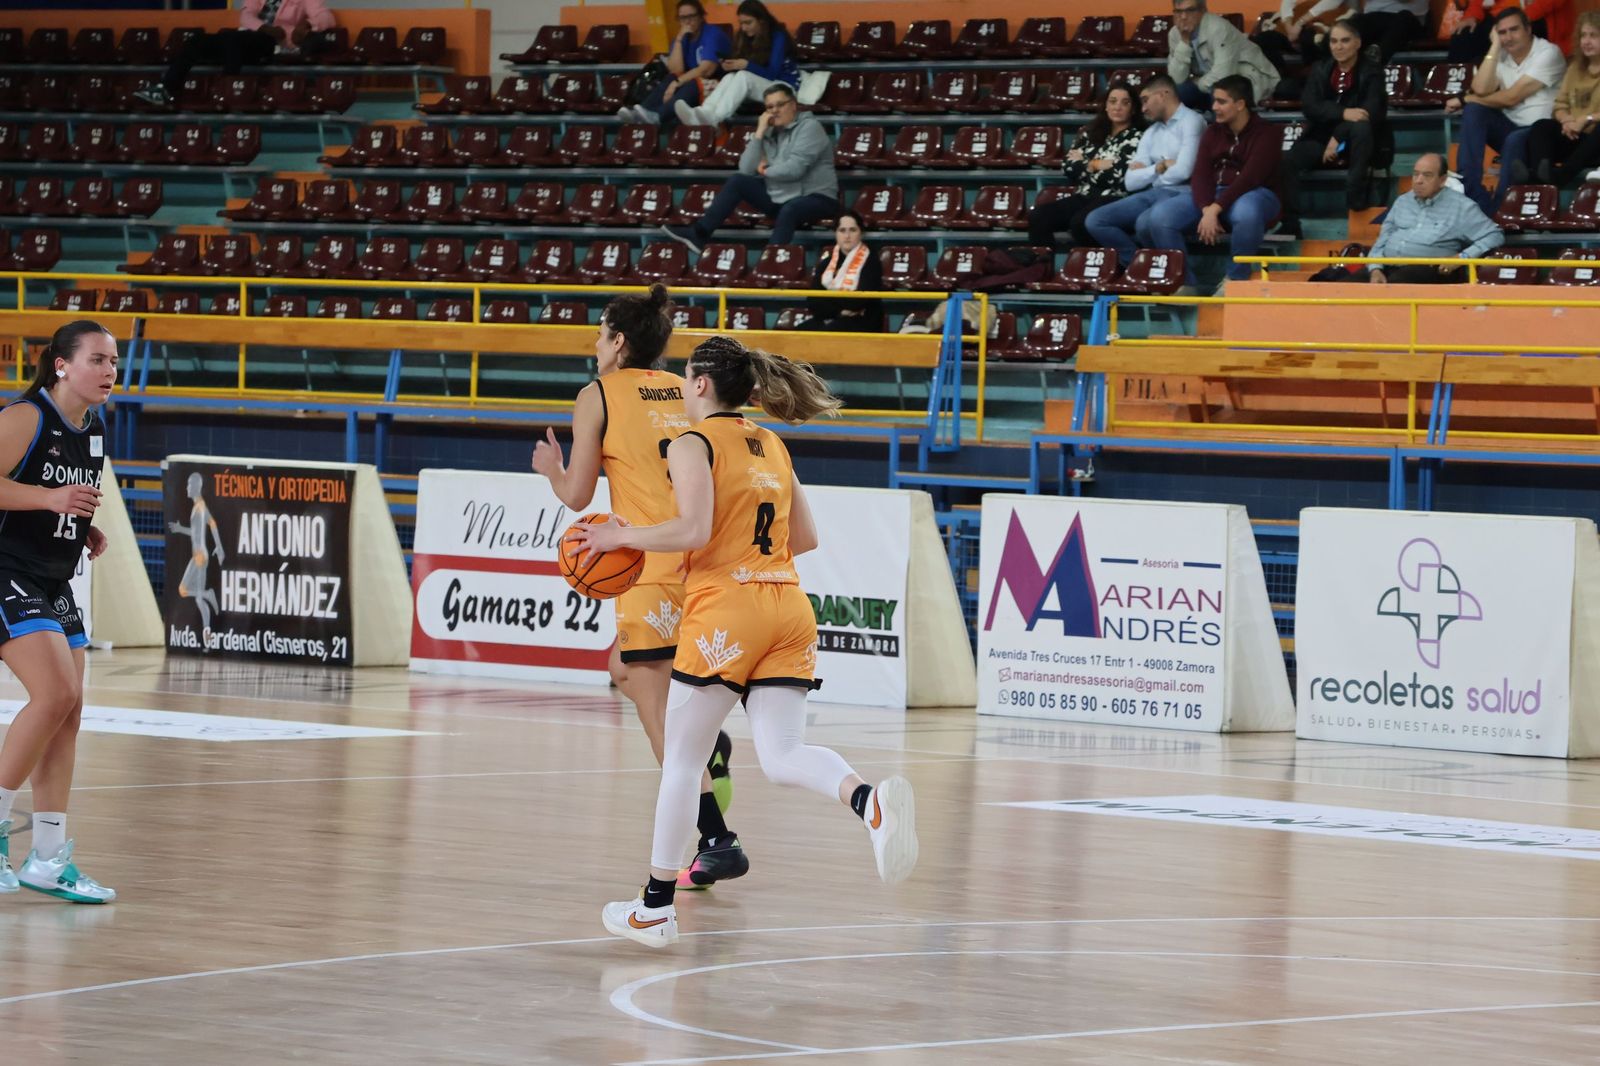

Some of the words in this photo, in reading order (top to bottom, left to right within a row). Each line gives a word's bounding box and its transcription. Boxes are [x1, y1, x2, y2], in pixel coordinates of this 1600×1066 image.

[214, 469, 264, 498] TÉCNICA
[268, 478, 276, 498] Y
[279, 479, 347, 503] ORTOPEDIA
[53, 513, 77, 540] 15
[237, 512, 326, 559] ANTONIO
[752, 502, 775, 556] 4
[1142, 557, 1179, 570] Asesoria
[221, 562, 341, 619] HERNÁNDEZ
[442, 577, 554, 632] Gamazo
[564, 590, 603, 633] 22
[170, 623, 201, 649] Avda.
[203, 625, 261, 654] Cardenal
[263, 629, 329, 662] Cisneros,
[331, 636, 347, 660] 21
[833, 635, 846, 649] DE
[850, 637, 897, 653] ZAMORA
[988, 648, 1028, 662] Avenida
[1030, 650, 1050, 663] Tres
[1053, 652, 1087, 666] Cruces
[1090, 655, 1101, 666] 17
[1105, 656, 1126, 668] Entr
[1144, 659, 1174, 672] 49008
[1176, 660, 1215, 674] Zamora
[1013, 670, 1205, 694] marianandresasesoria@gmail.com
[1310, 670, 1454, 710] recoletas
[1467, 677, 1542, 715] salud
[1010, 690, 1036, 707] 980
[1039, 691, 1056, 709] 05
[1060, 693, 1077, 711] 85
[1081, 694, 1098, 712] 90
[1111, 697, 1137, 715] 605
[1141, 699, 1159, 717] 76
[1163, 700, 1179, 718] 71
[1184, 702, 1202, 720] 05
[1310, 714, 1363, 728] SALUD.
[1368, 718, 1456, 735] BIENESTAR.
[1462, 724, 1541, 741] PERSONAS.
